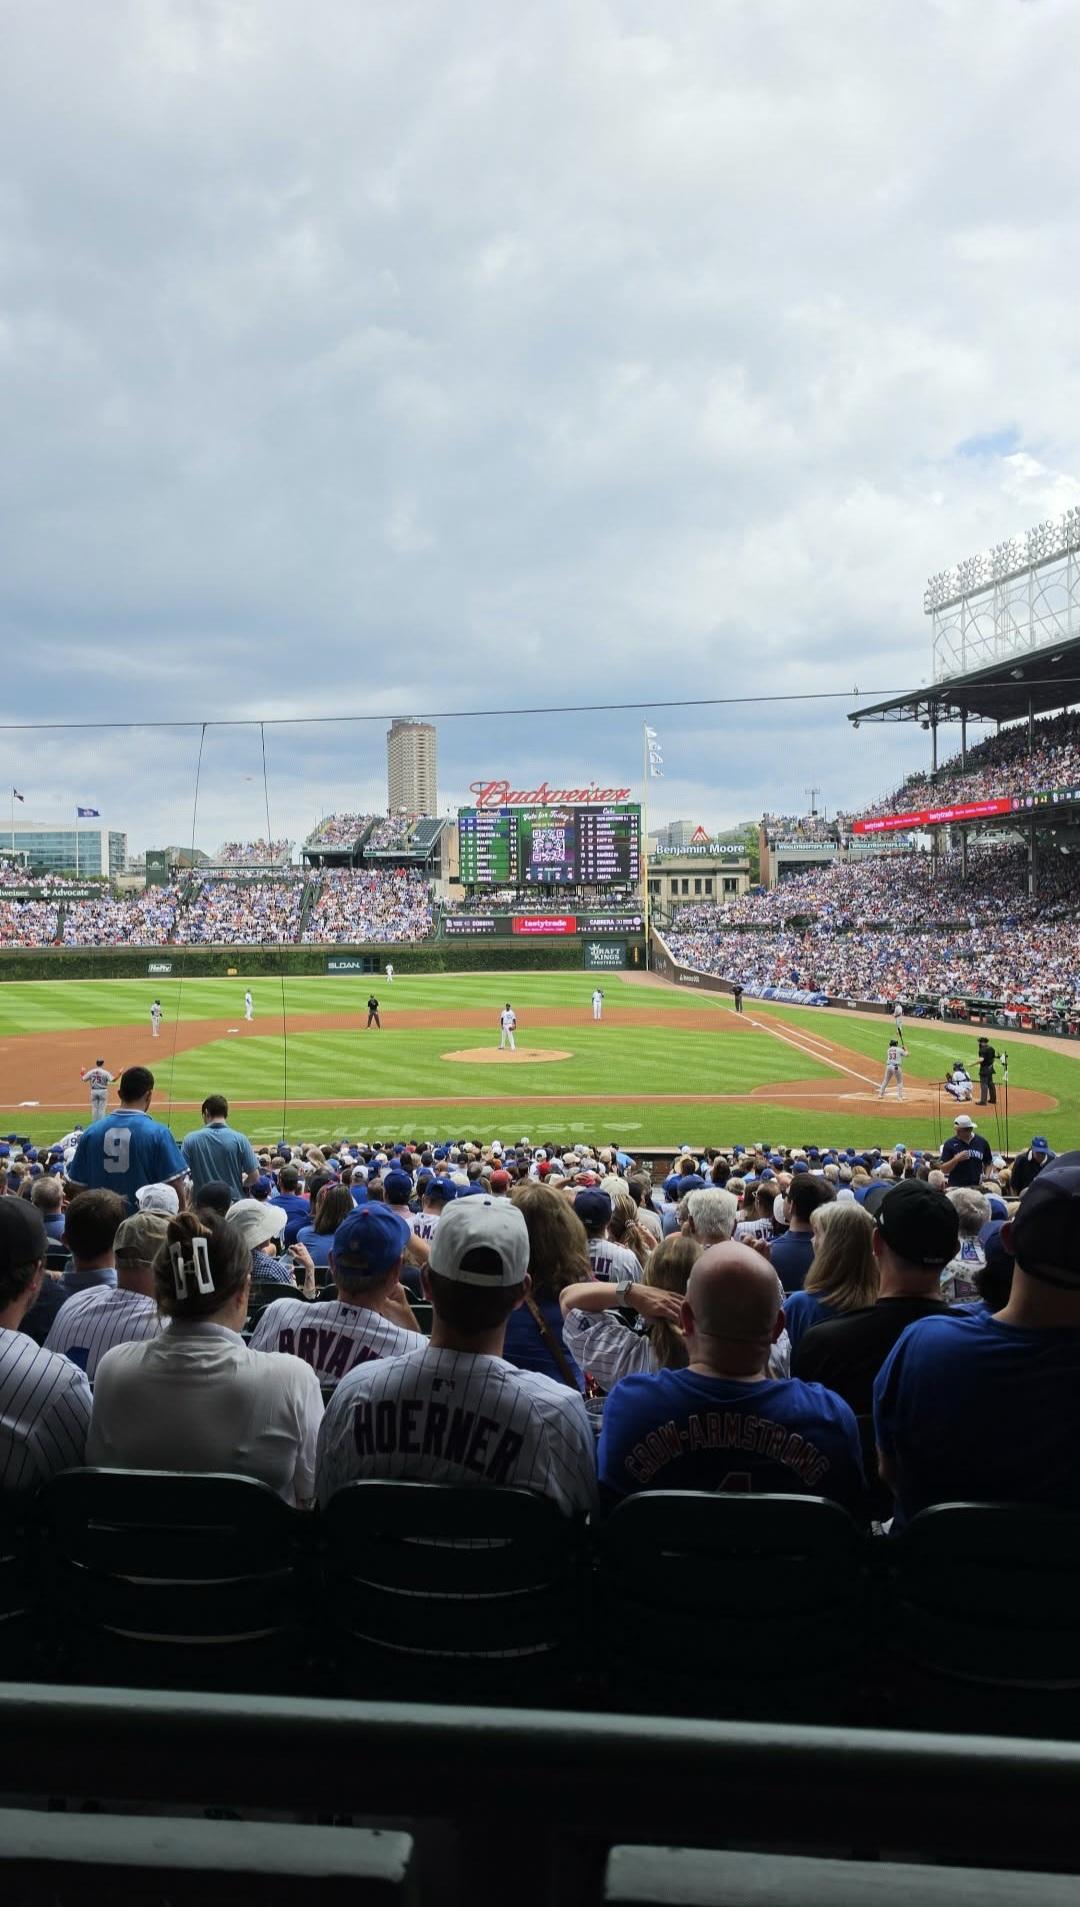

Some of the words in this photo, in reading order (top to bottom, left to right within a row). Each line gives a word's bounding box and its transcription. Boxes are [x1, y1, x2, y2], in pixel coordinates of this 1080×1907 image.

[469, 781, 631, 807] Budweiser
[523, 813, 537, 821] Vote
[538, 811, 548, 819] for
[656, 844, 706, 856] Benjamin
[709, 844, 745, 853] Moore
[52, 888, 89, 897] Advocate
[524, 919, 567, 929] tastytrade
[592, 948, 621, 956] DRAFT
[92, 1075, 102, 1084] 75
[248, 1122, 596, 1139] Southwest
[103, 1127, 132, 1174] 9
[353, 1399, 525, 1482] HOERNER
[624, 1411, 831, 1487] CROW-ARMSTRONG
